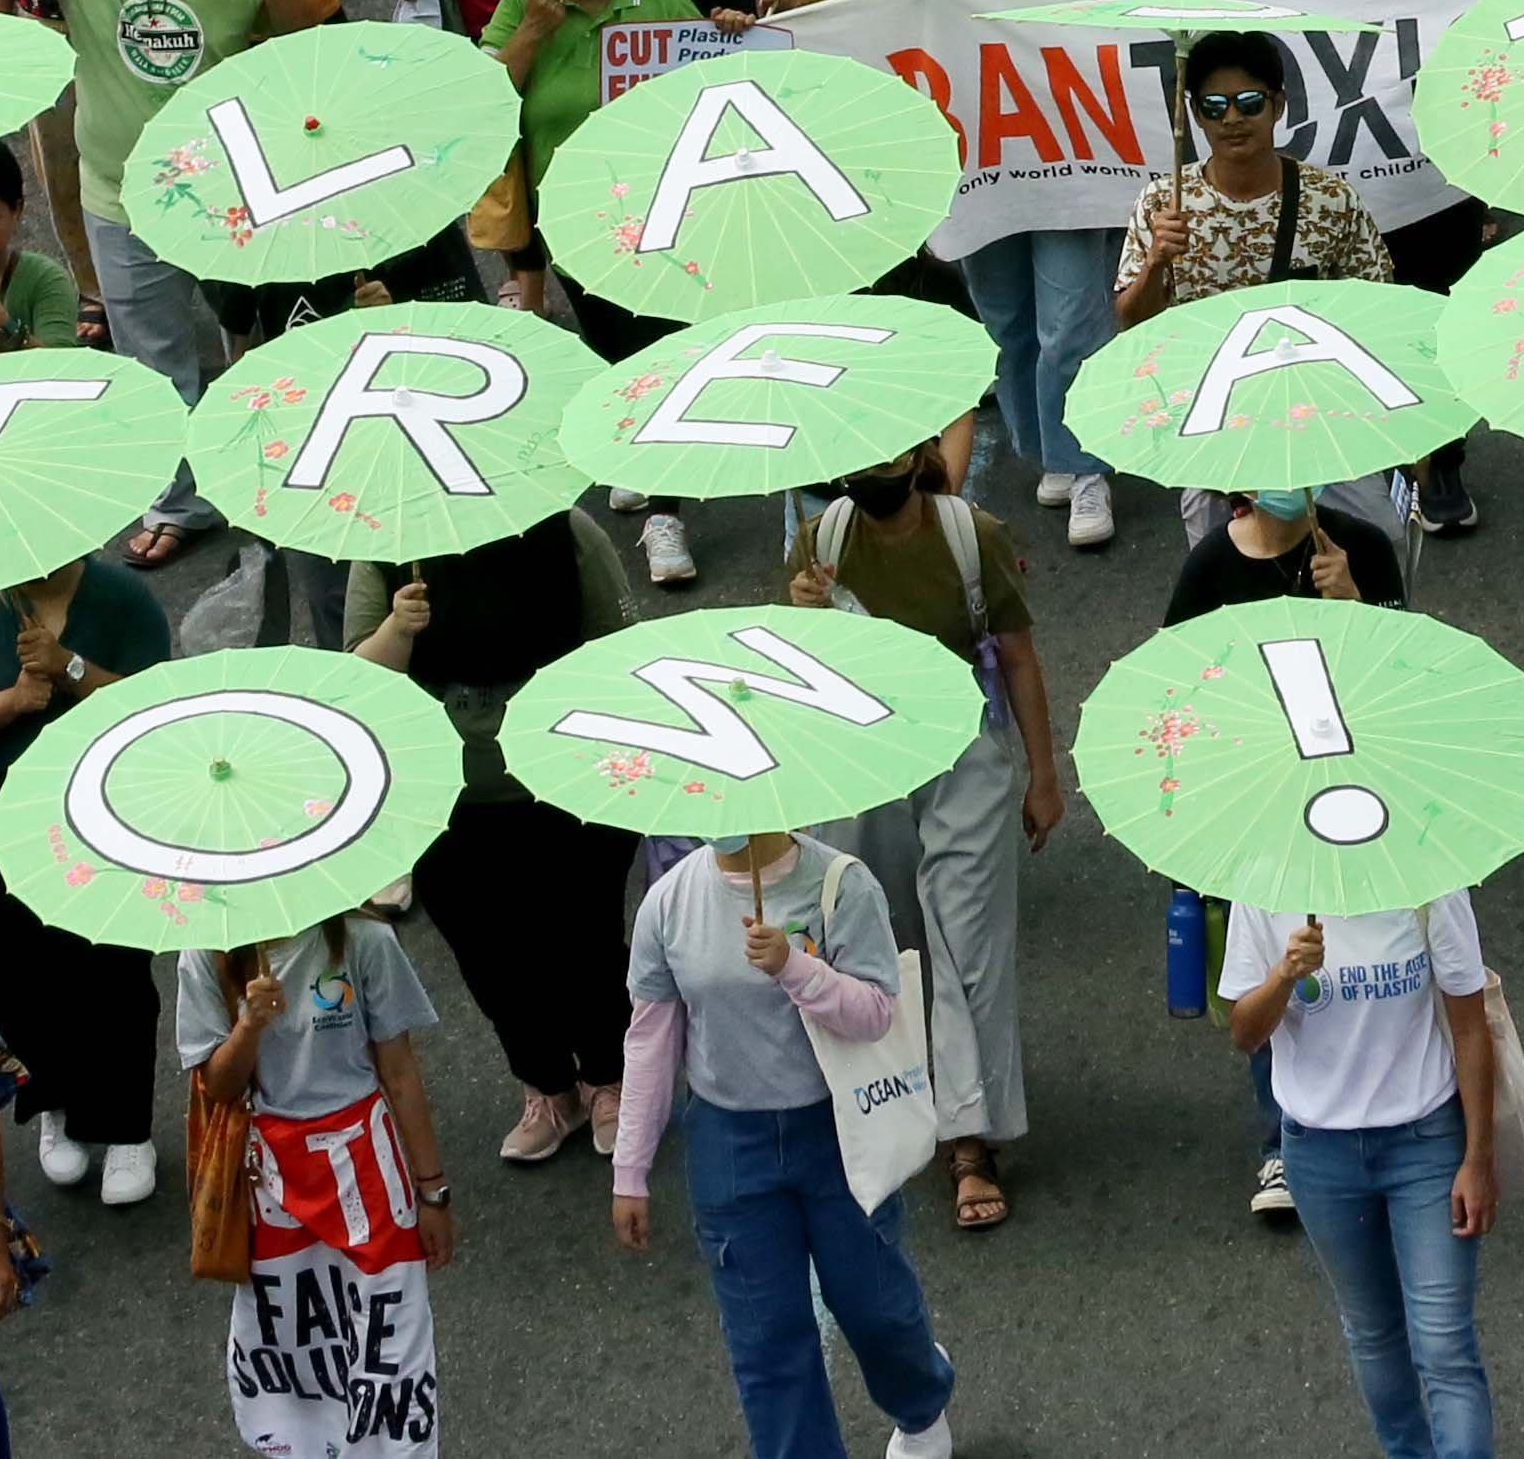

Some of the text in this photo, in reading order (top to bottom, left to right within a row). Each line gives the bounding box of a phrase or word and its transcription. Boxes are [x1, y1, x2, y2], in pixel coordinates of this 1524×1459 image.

[607, 29, 673, 67] CUT
[678, 29, 743, 45] Plastic
[958, 156, 1428, 196] only world worth childr
[1339, 950, 1427, 985] END THE AGE
[1341, 974, 1421, 1001] OF PLASTIC
[234, 1337, 436, 1442] SOLUONS
